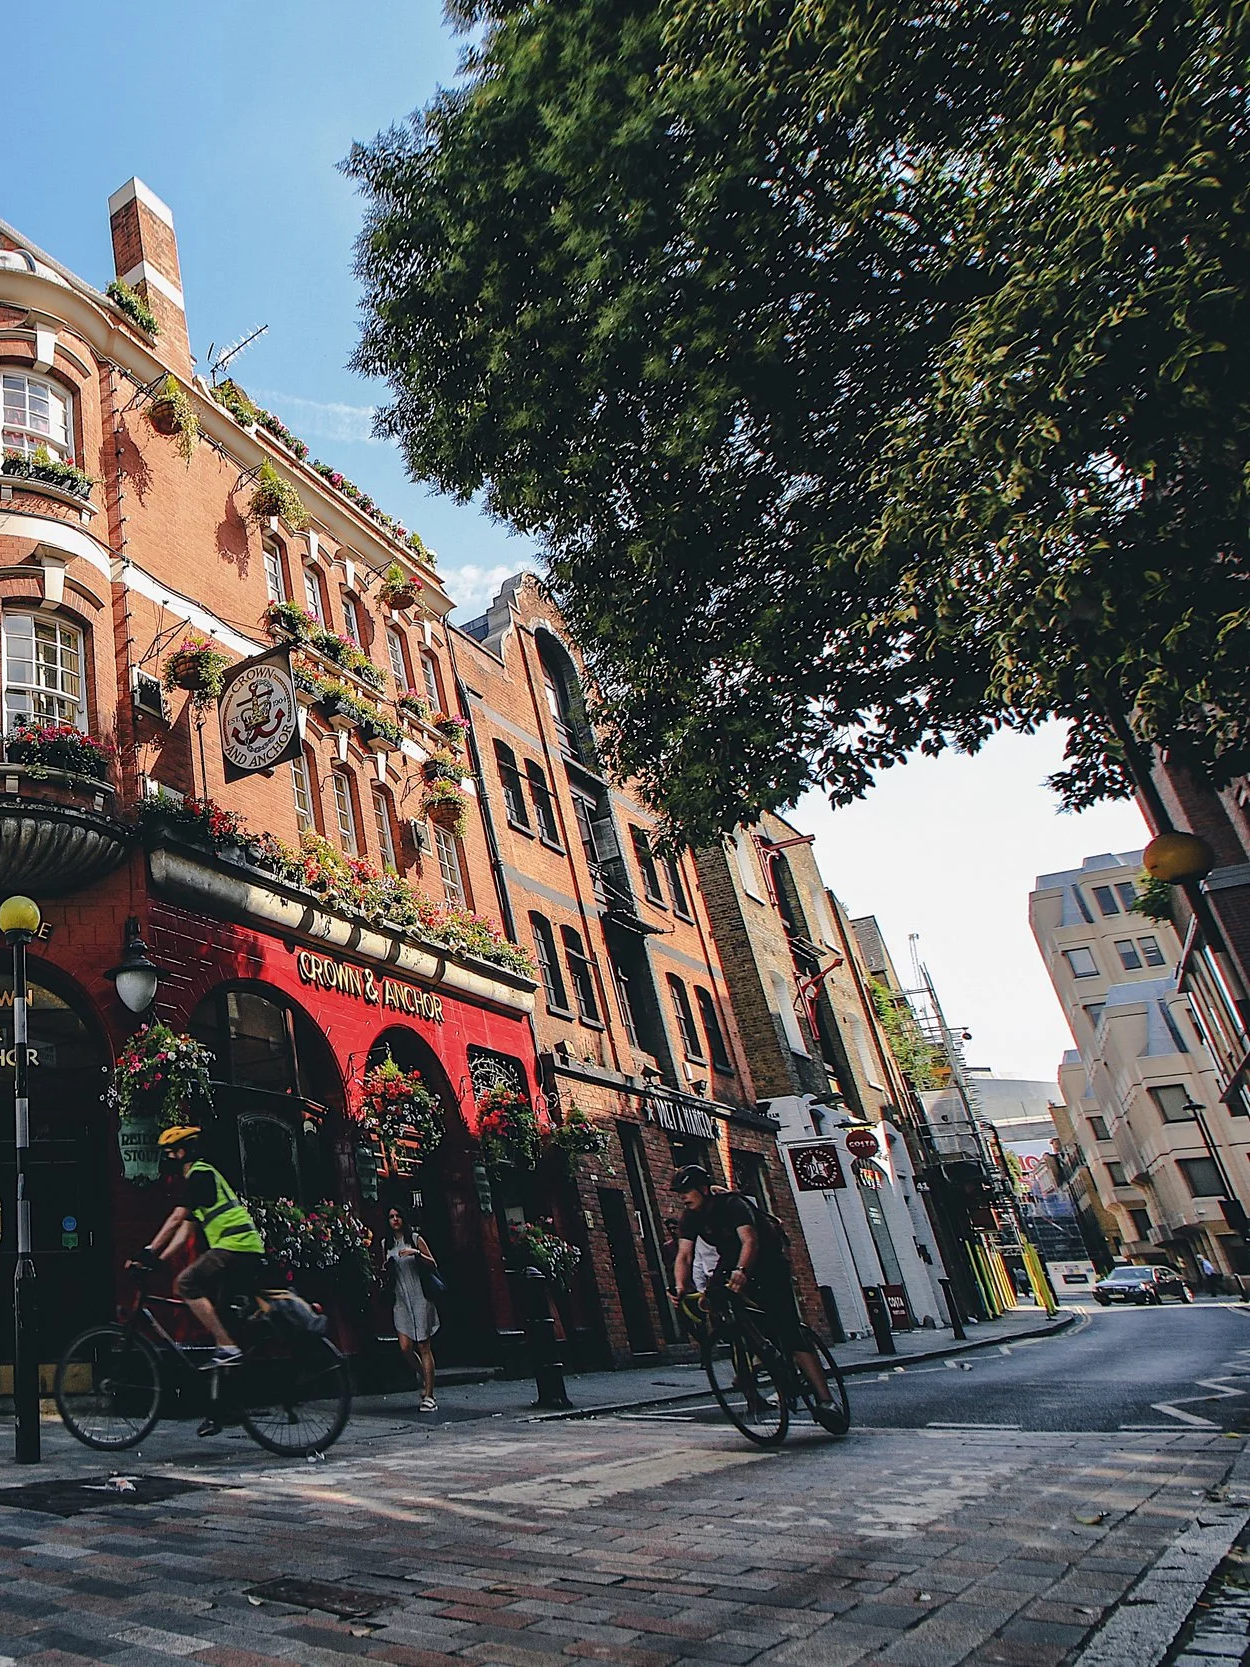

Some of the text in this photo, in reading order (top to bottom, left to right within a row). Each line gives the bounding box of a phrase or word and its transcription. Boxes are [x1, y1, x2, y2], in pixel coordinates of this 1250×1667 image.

[231, 667, 276, 694] CROWN
[225, 724, 293, 767] AND ANCHOR
[300, 951, 446, 1023] CROWN & ANCHOR
[849, 1140, 876, 1148] COSTA
